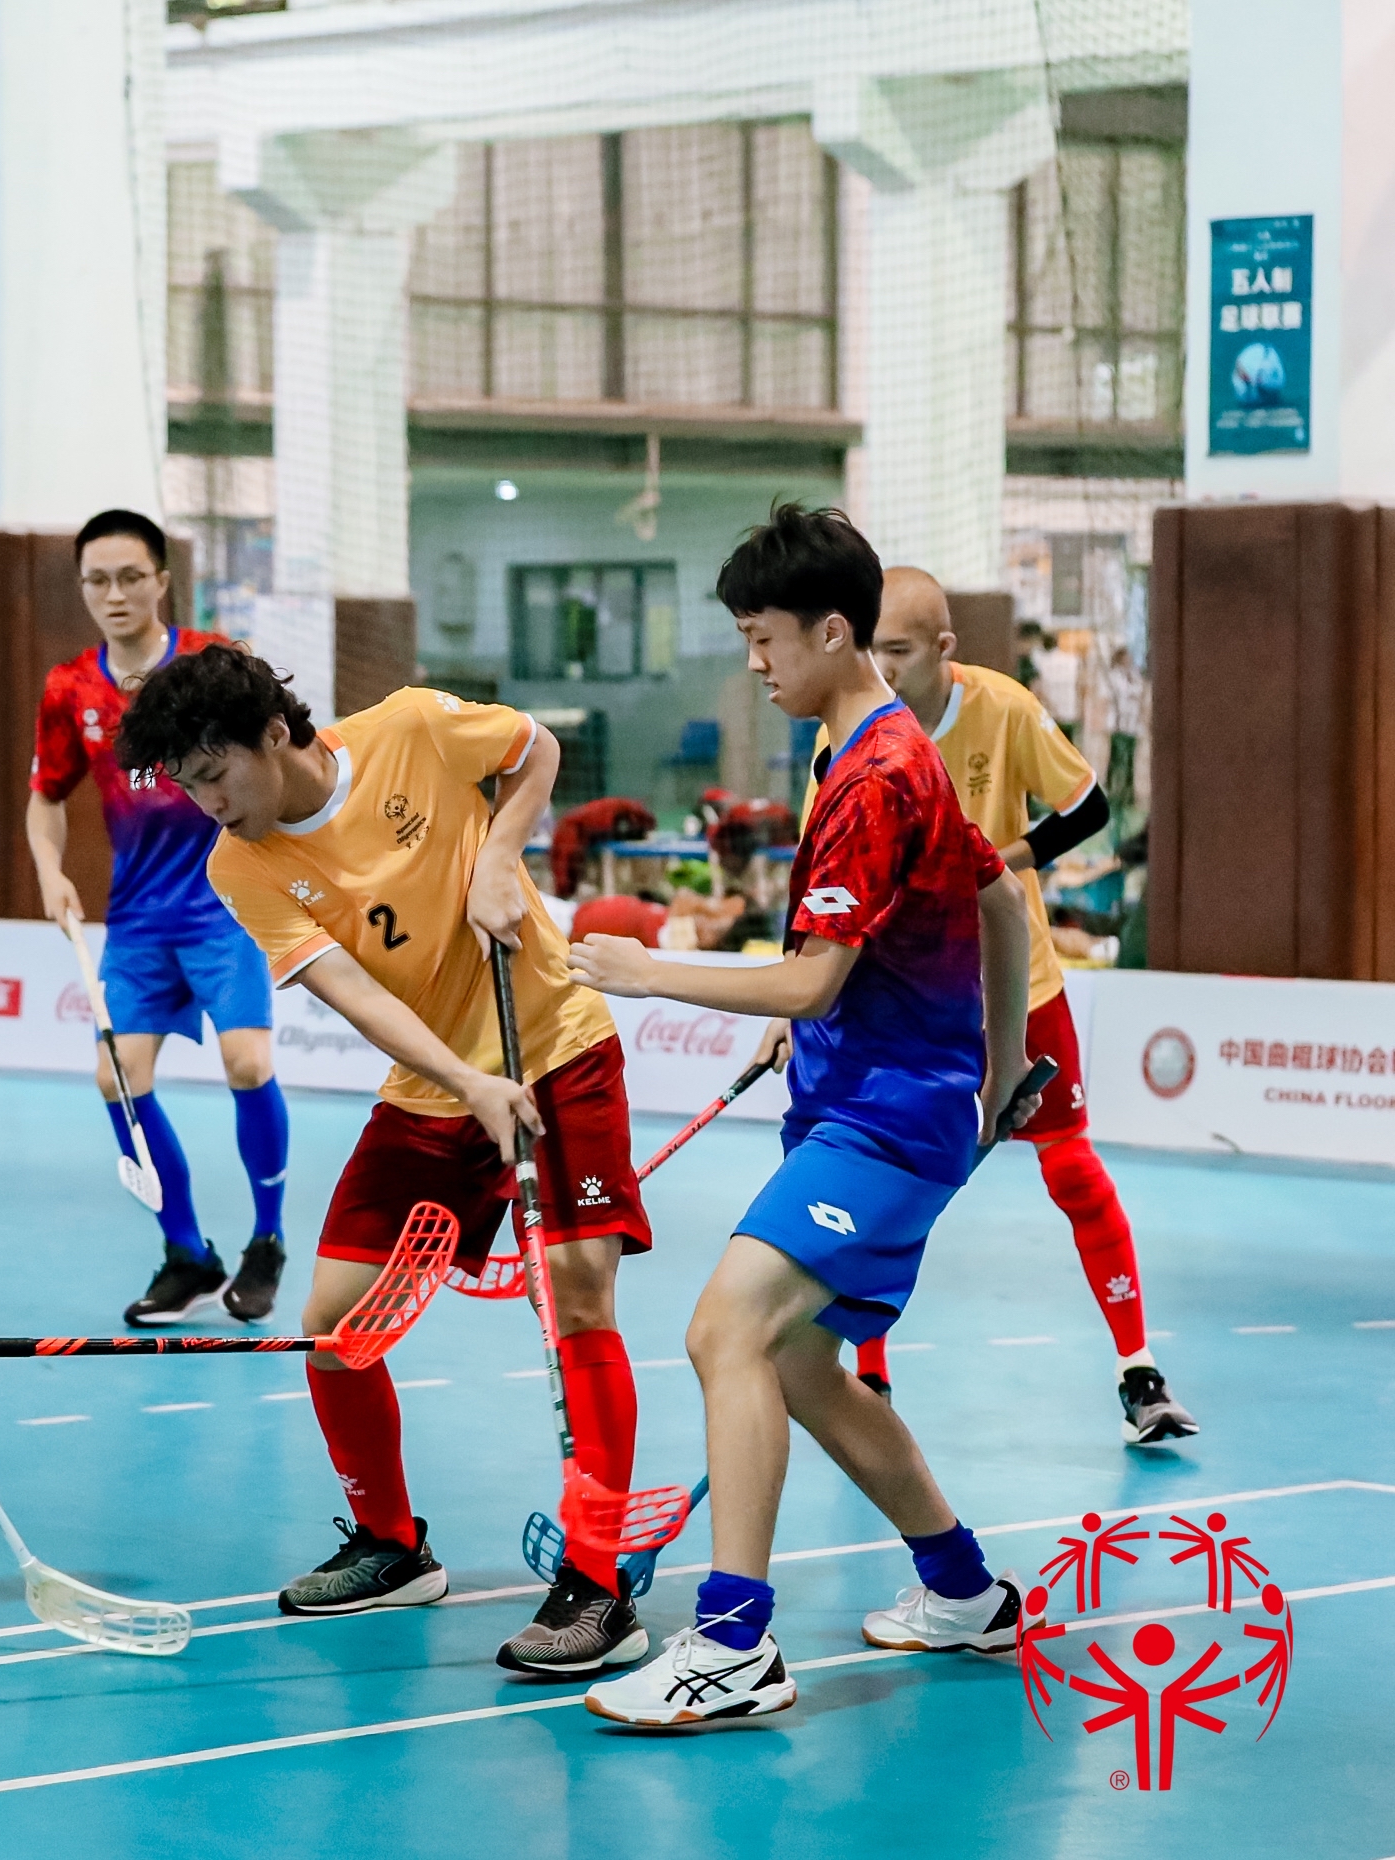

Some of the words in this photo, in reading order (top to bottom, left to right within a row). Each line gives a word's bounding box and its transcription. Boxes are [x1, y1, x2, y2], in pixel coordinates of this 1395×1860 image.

[367, 903, 411, 951] 2
[635, 1009, 737, 1057] Coca-Cola
[1219, 1037, 1395, 1076] 中国曲棍球协会
[1265, 1087, 1326, 1105] CHINA
[577, 1196, 611, 1206] KELME
